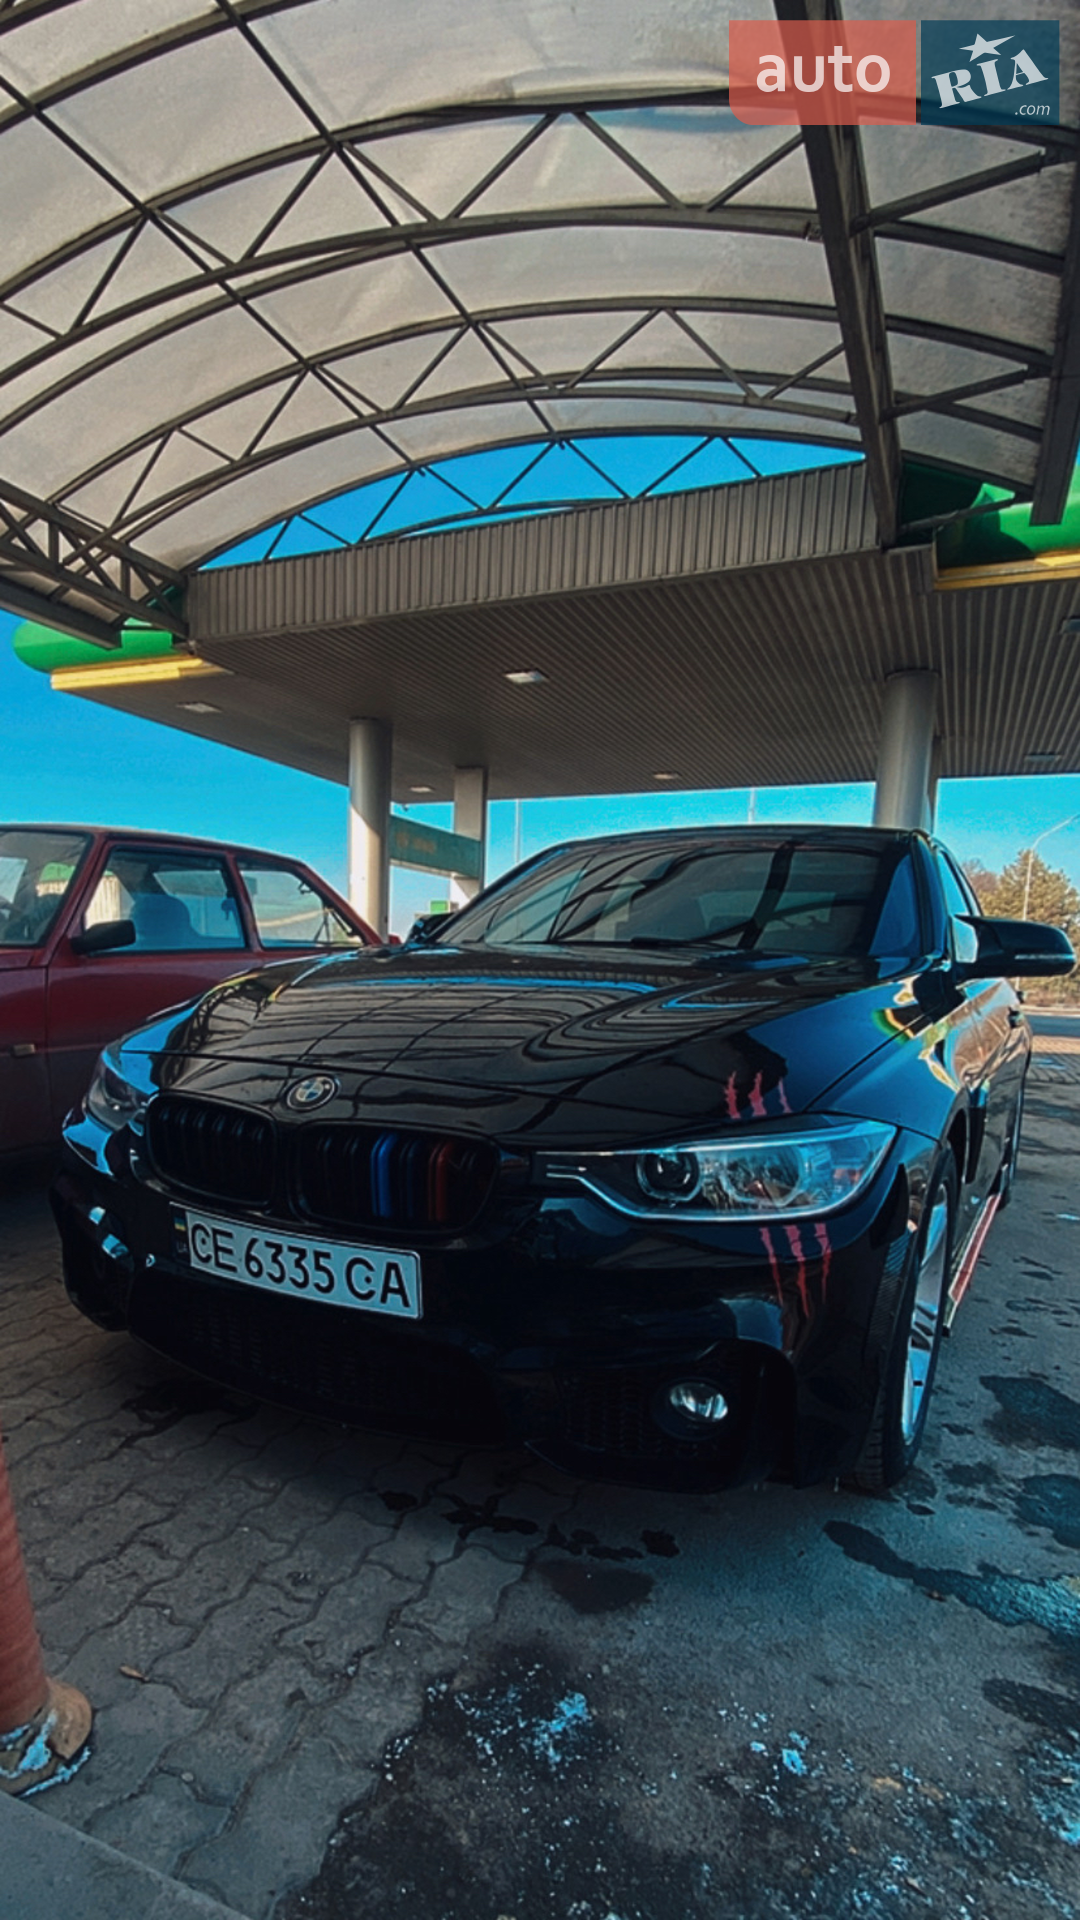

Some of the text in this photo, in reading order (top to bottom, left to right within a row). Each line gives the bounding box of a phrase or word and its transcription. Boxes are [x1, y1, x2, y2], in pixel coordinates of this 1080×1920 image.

[190, 1223, 411, 1309] CE 6335 CA
